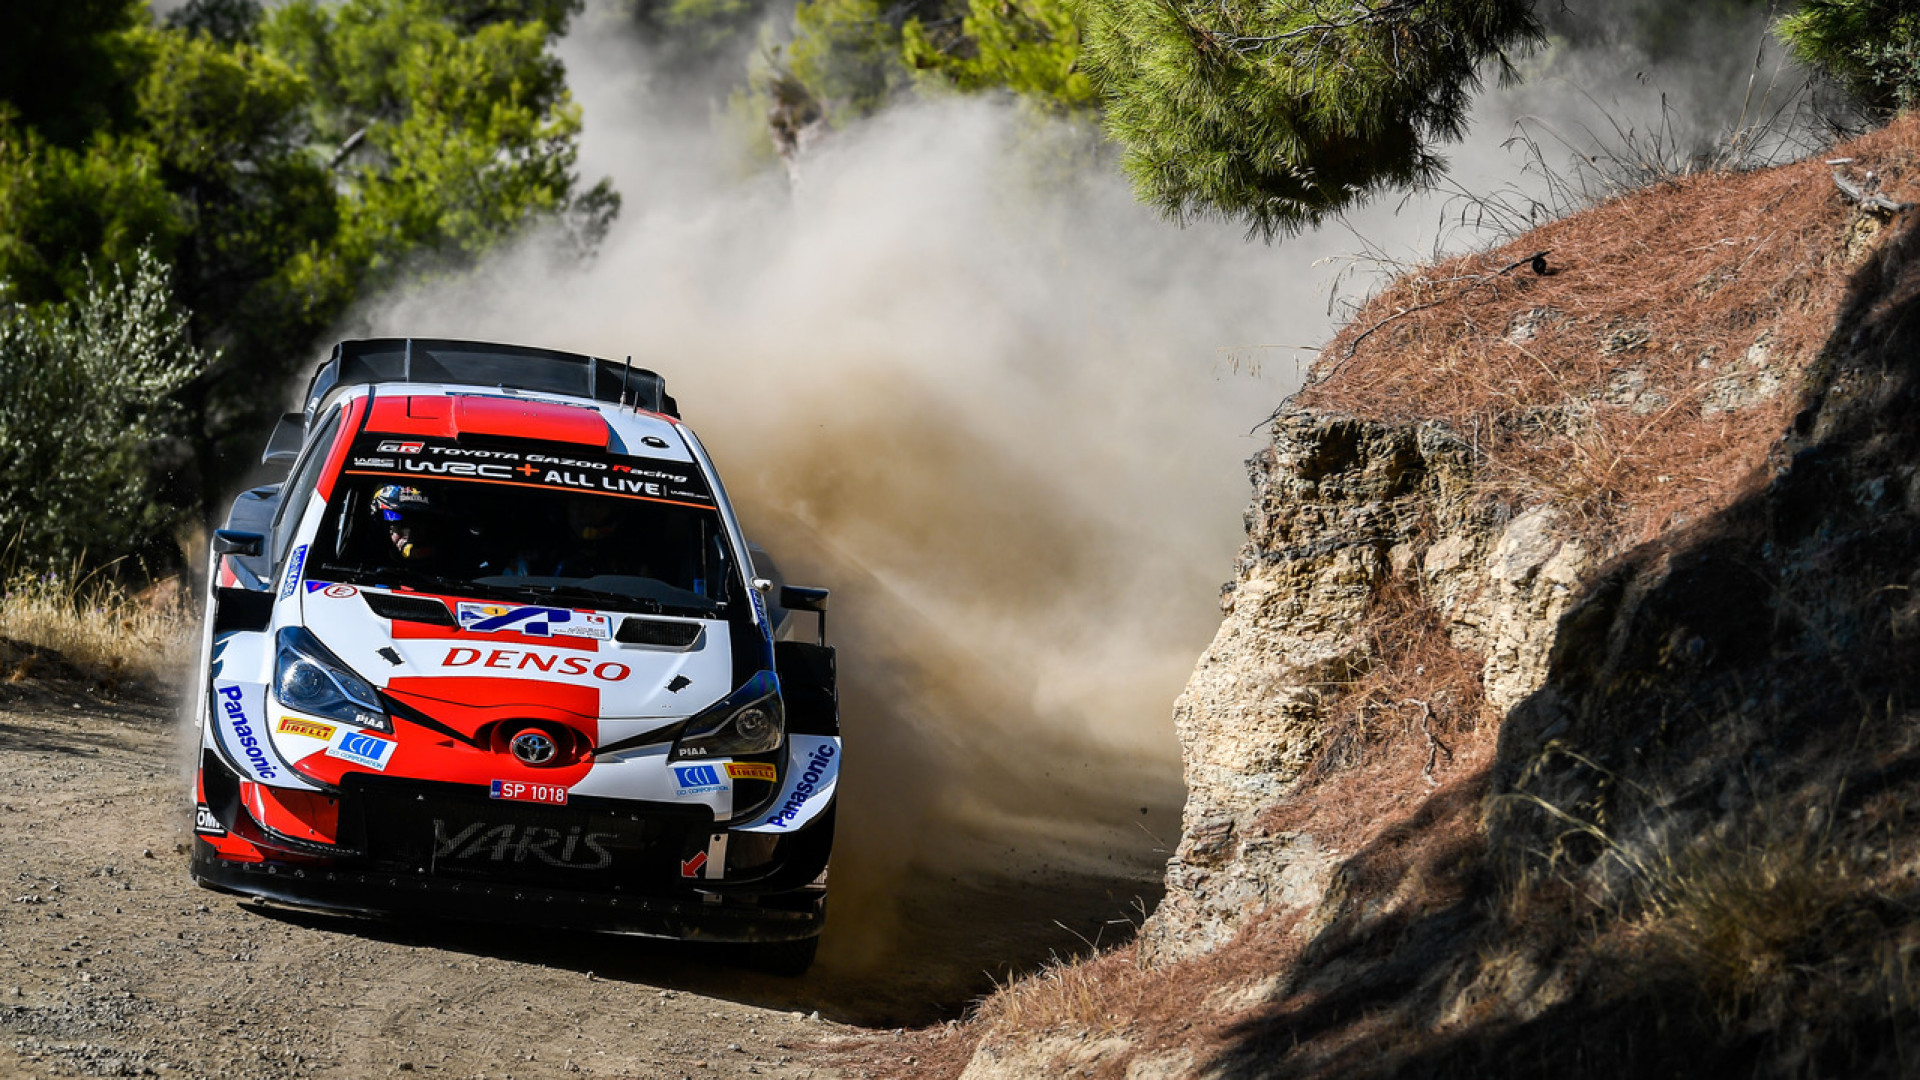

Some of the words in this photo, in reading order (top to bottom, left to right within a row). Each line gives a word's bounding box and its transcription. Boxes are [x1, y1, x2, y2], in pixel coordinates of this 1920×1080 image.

[379, 444, 420, 454] GR
[429, 446, 519, 461] TOYOTA
[525, 453, 608, 470] GAZOO
[612, 464, 688, 483] Racing
[544, 470, 595, 488] ALL
[602, 476, 661, 496] LIVE
[441, 647, 632, 682] DENSO
[218, 684, 277, 780] Panasonic
[280, 719, 333, 738] PIRELLI
[355, 713, 385, 730] PIAA
[679, 747, 708, 757] PIAA
[728, 764, 775, 779] PIRELLI
[502, 782, 526, 798] SP
[530, 785, 565, 803] 1018
[766, 743, 836, 828] Panasonic
